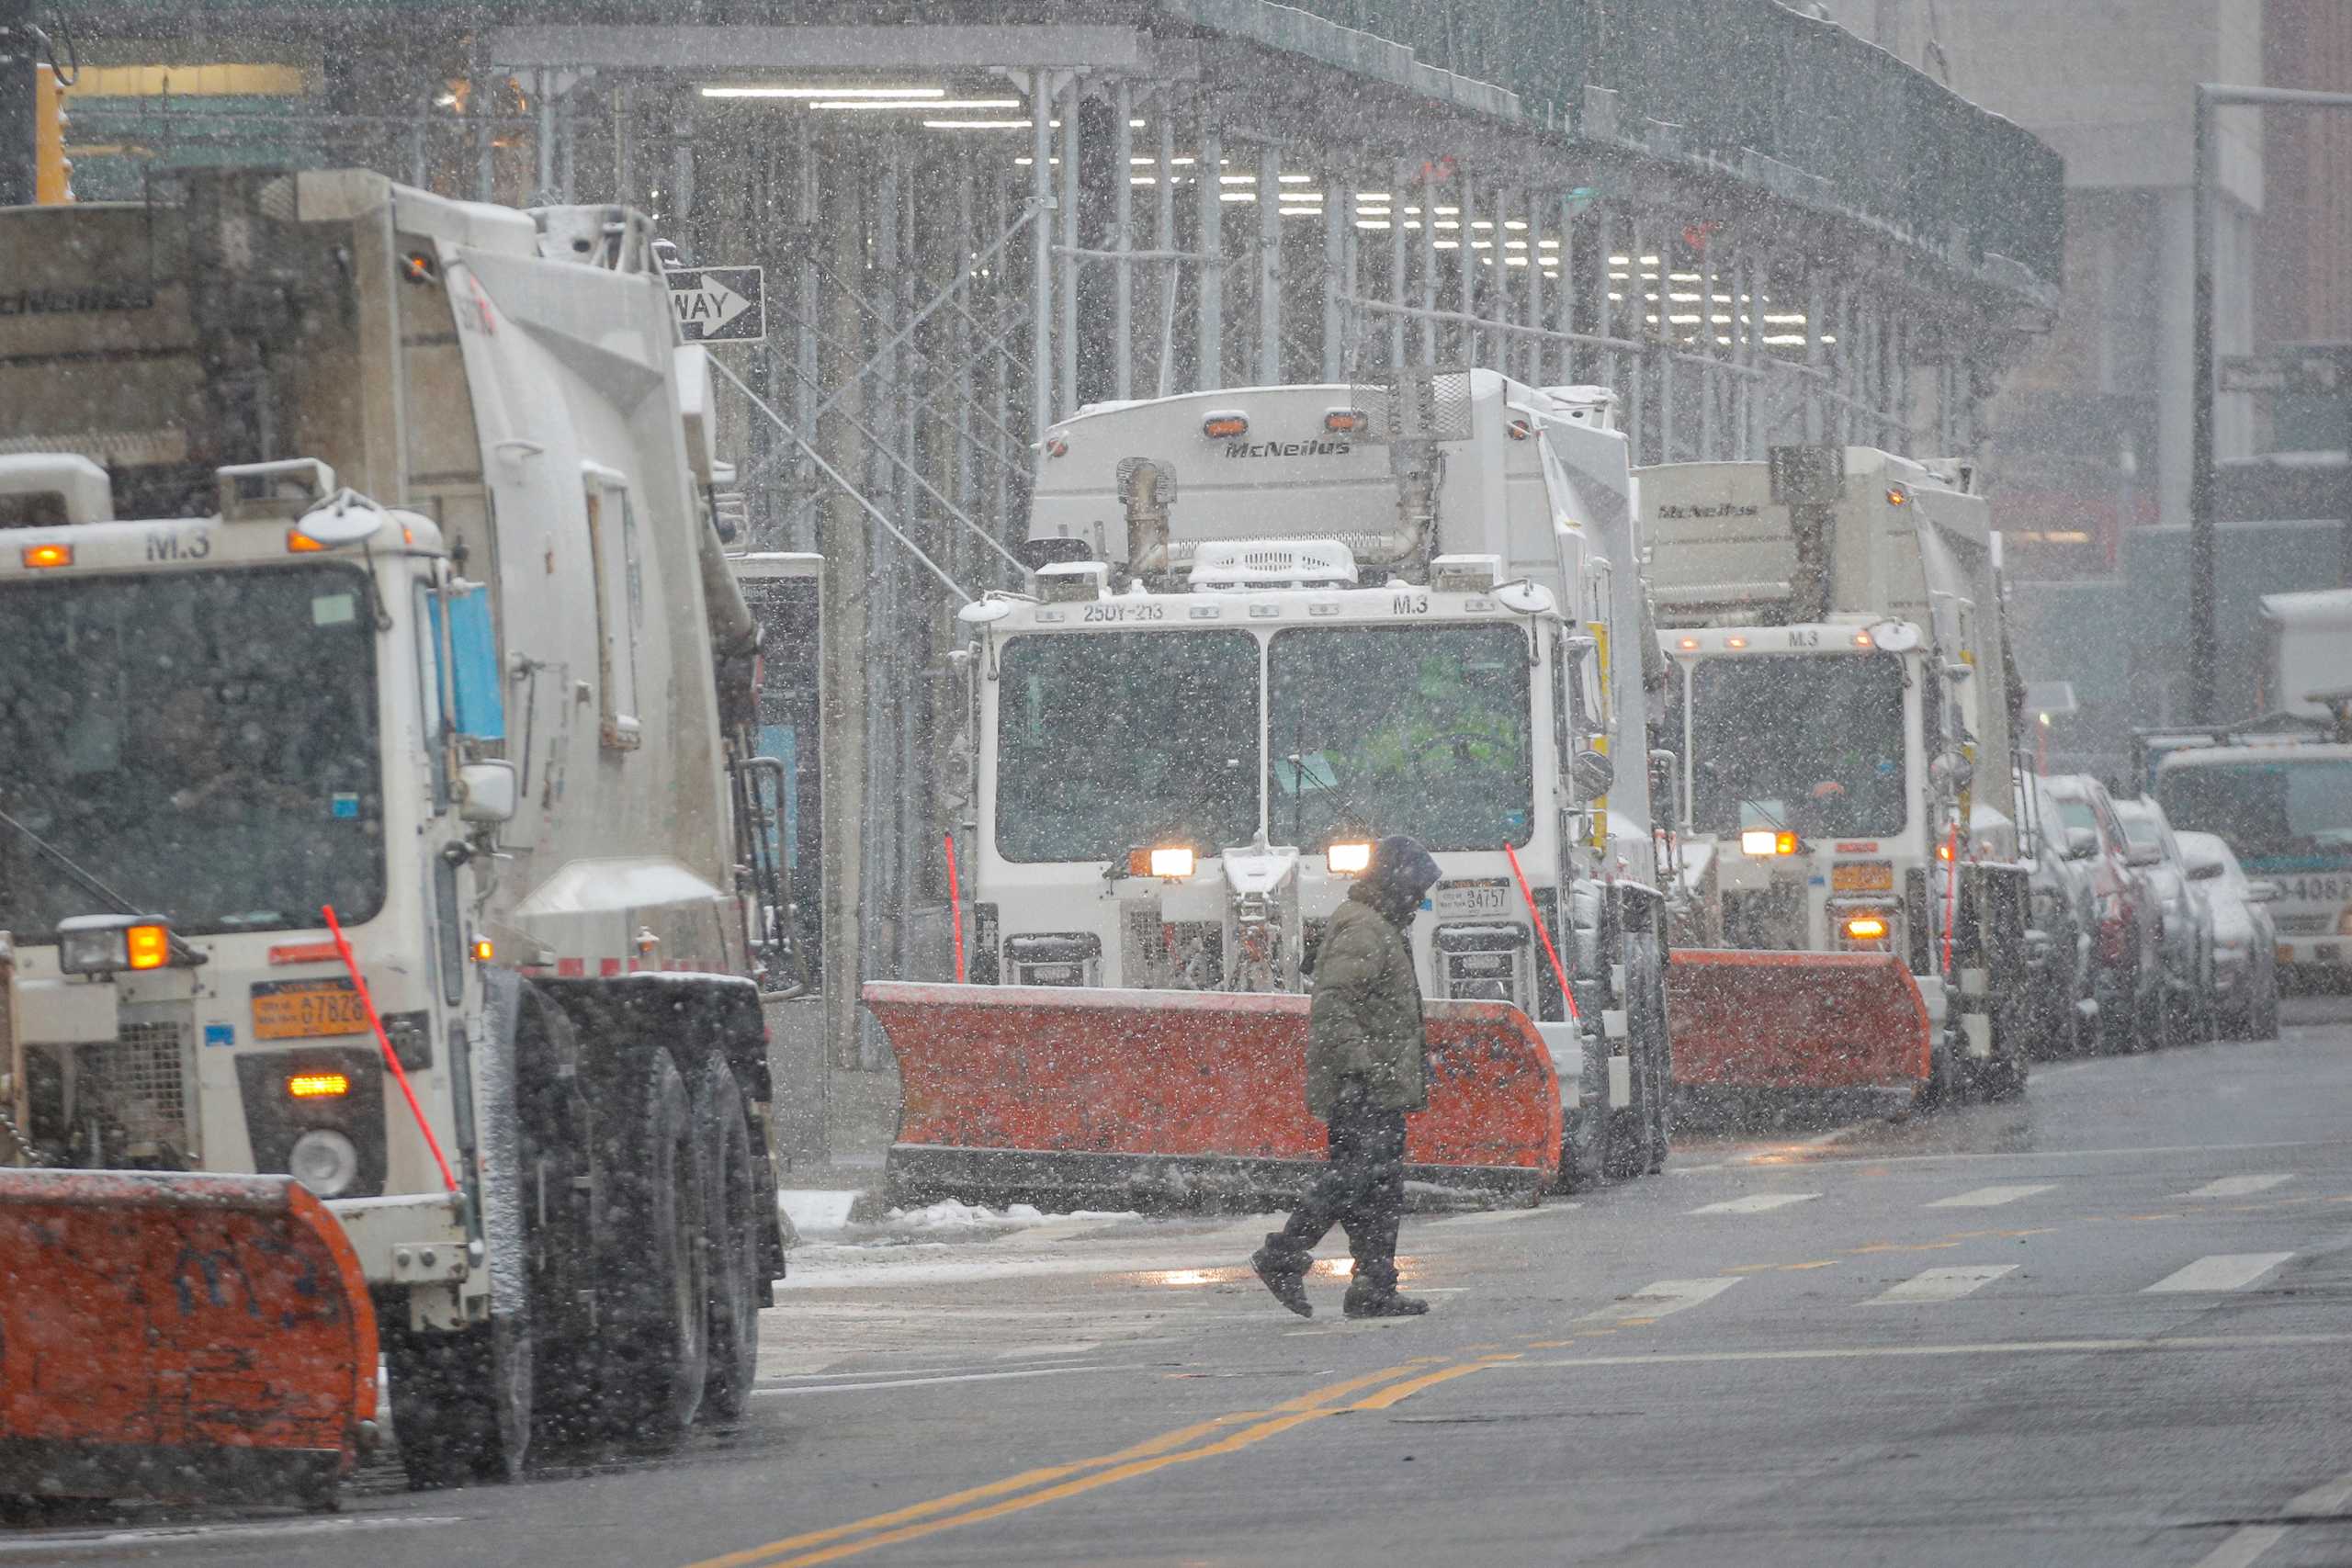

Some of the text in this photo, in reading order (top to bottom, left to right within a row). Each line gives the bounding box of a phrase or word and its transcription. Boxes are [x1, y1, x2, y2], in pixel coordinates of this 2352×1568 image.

[1225, 439, 1351, 458] McNeilus
[146, 531, 211, 561] M.3
[1393, 594, 1428, 615] M.3
[1788, 630, 1818, 647] M.3
